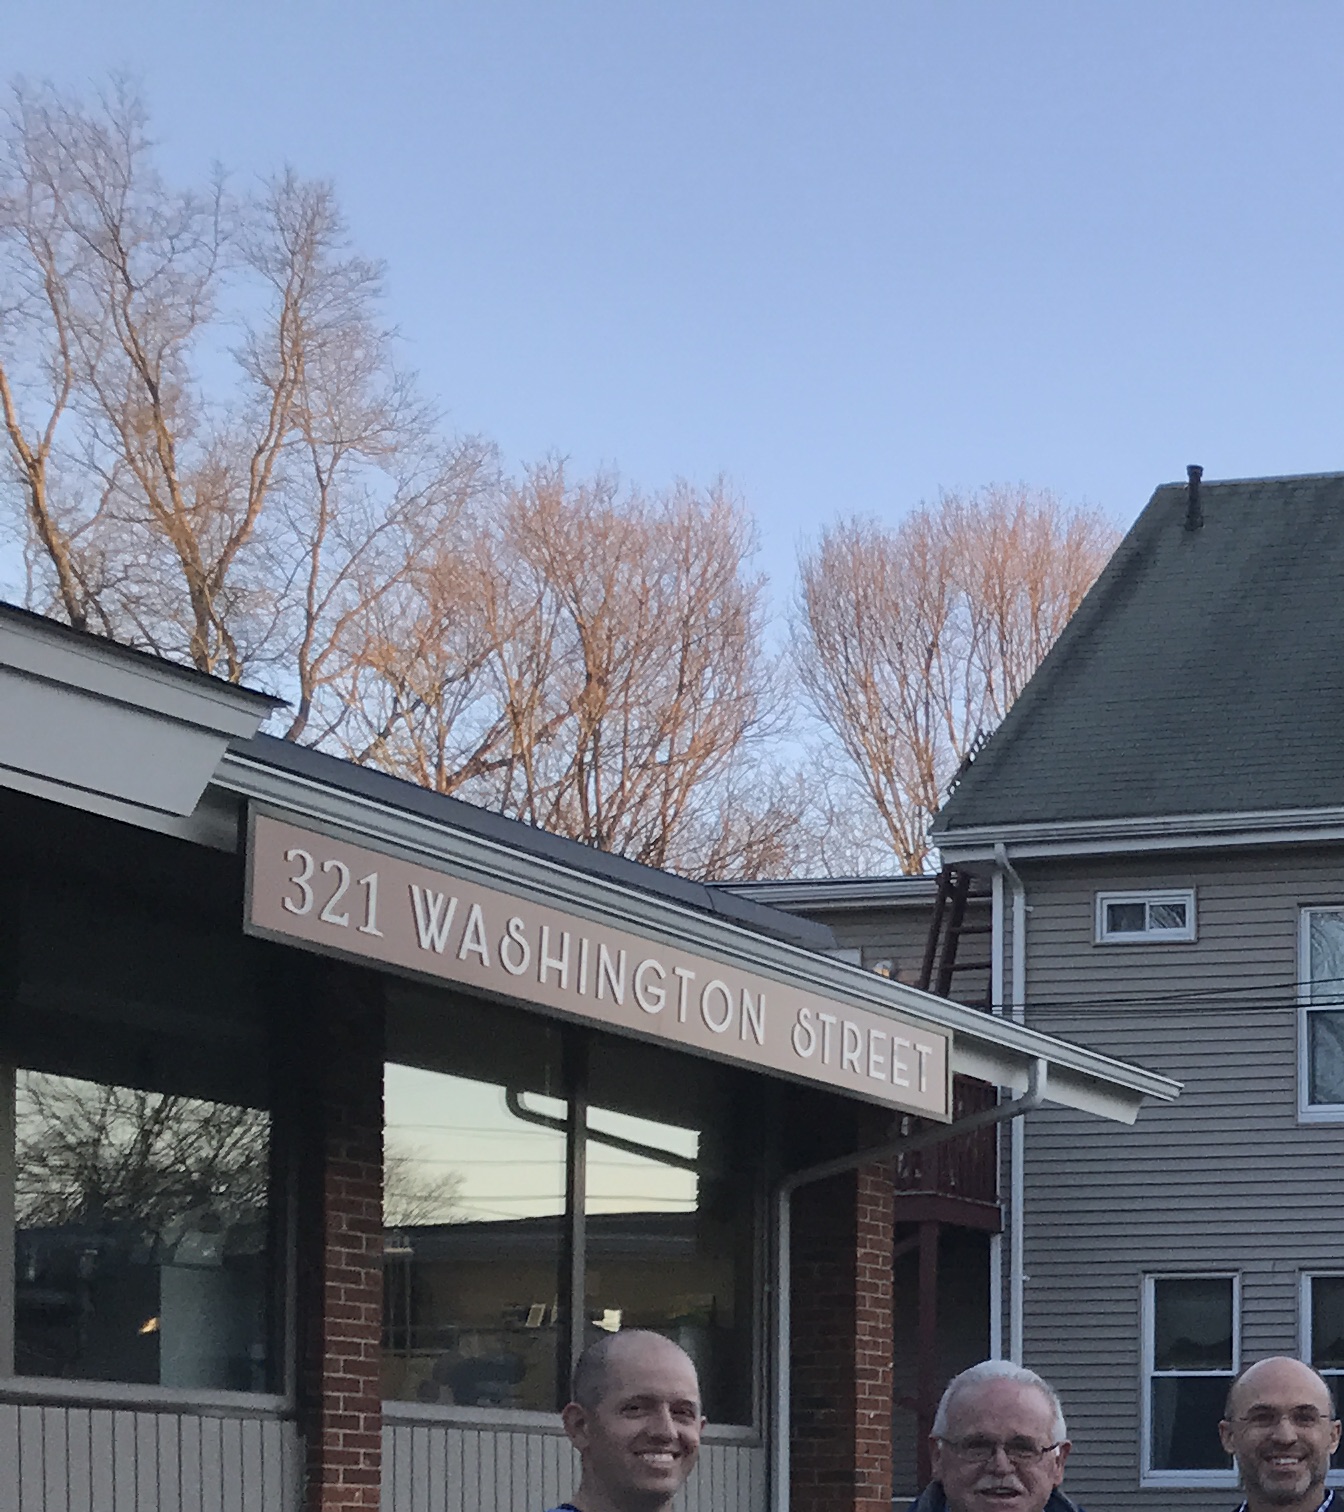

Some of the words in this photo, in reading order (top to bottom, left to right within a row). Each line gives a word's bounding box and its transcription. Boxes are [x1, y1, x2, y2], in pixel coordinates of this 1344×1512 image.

[281, 847, 384, 938] 321
[408, 884, 767, 1046] WASHINGTON
[791, 1005, 934, 1094] STREET
